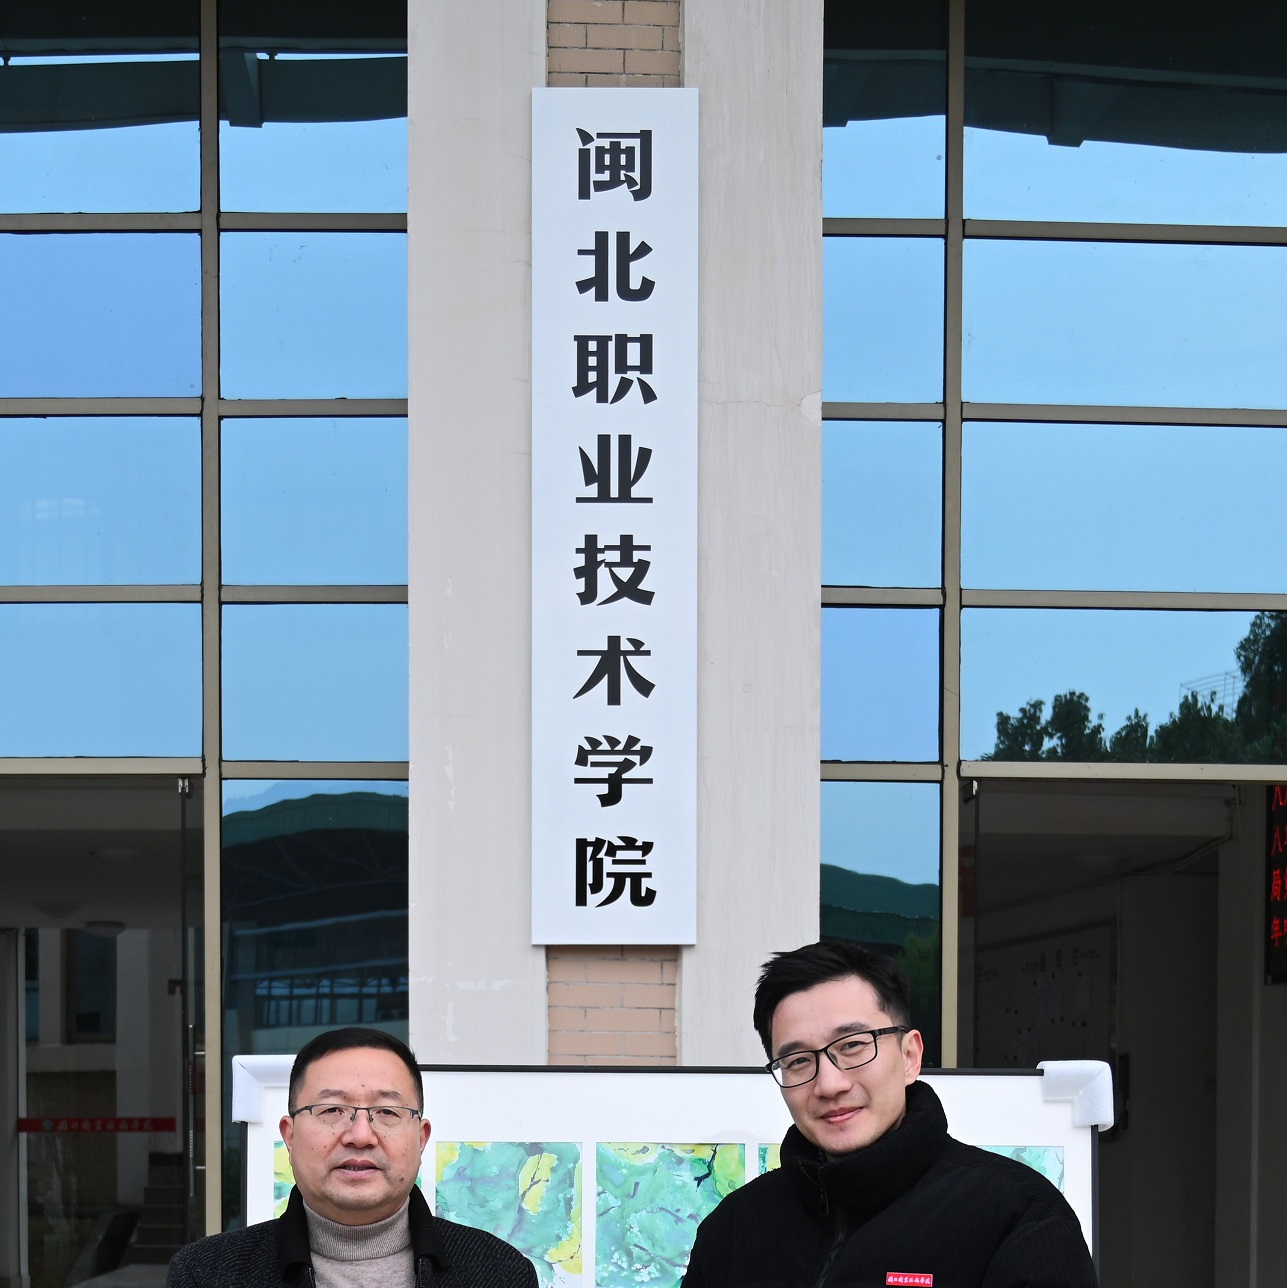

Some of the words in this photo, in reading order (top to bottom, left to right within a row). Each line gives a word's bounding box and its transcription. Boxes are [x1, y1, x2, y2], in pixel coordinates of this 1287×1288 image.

[572, 127, 658, 907] 闽北职业技术学院
